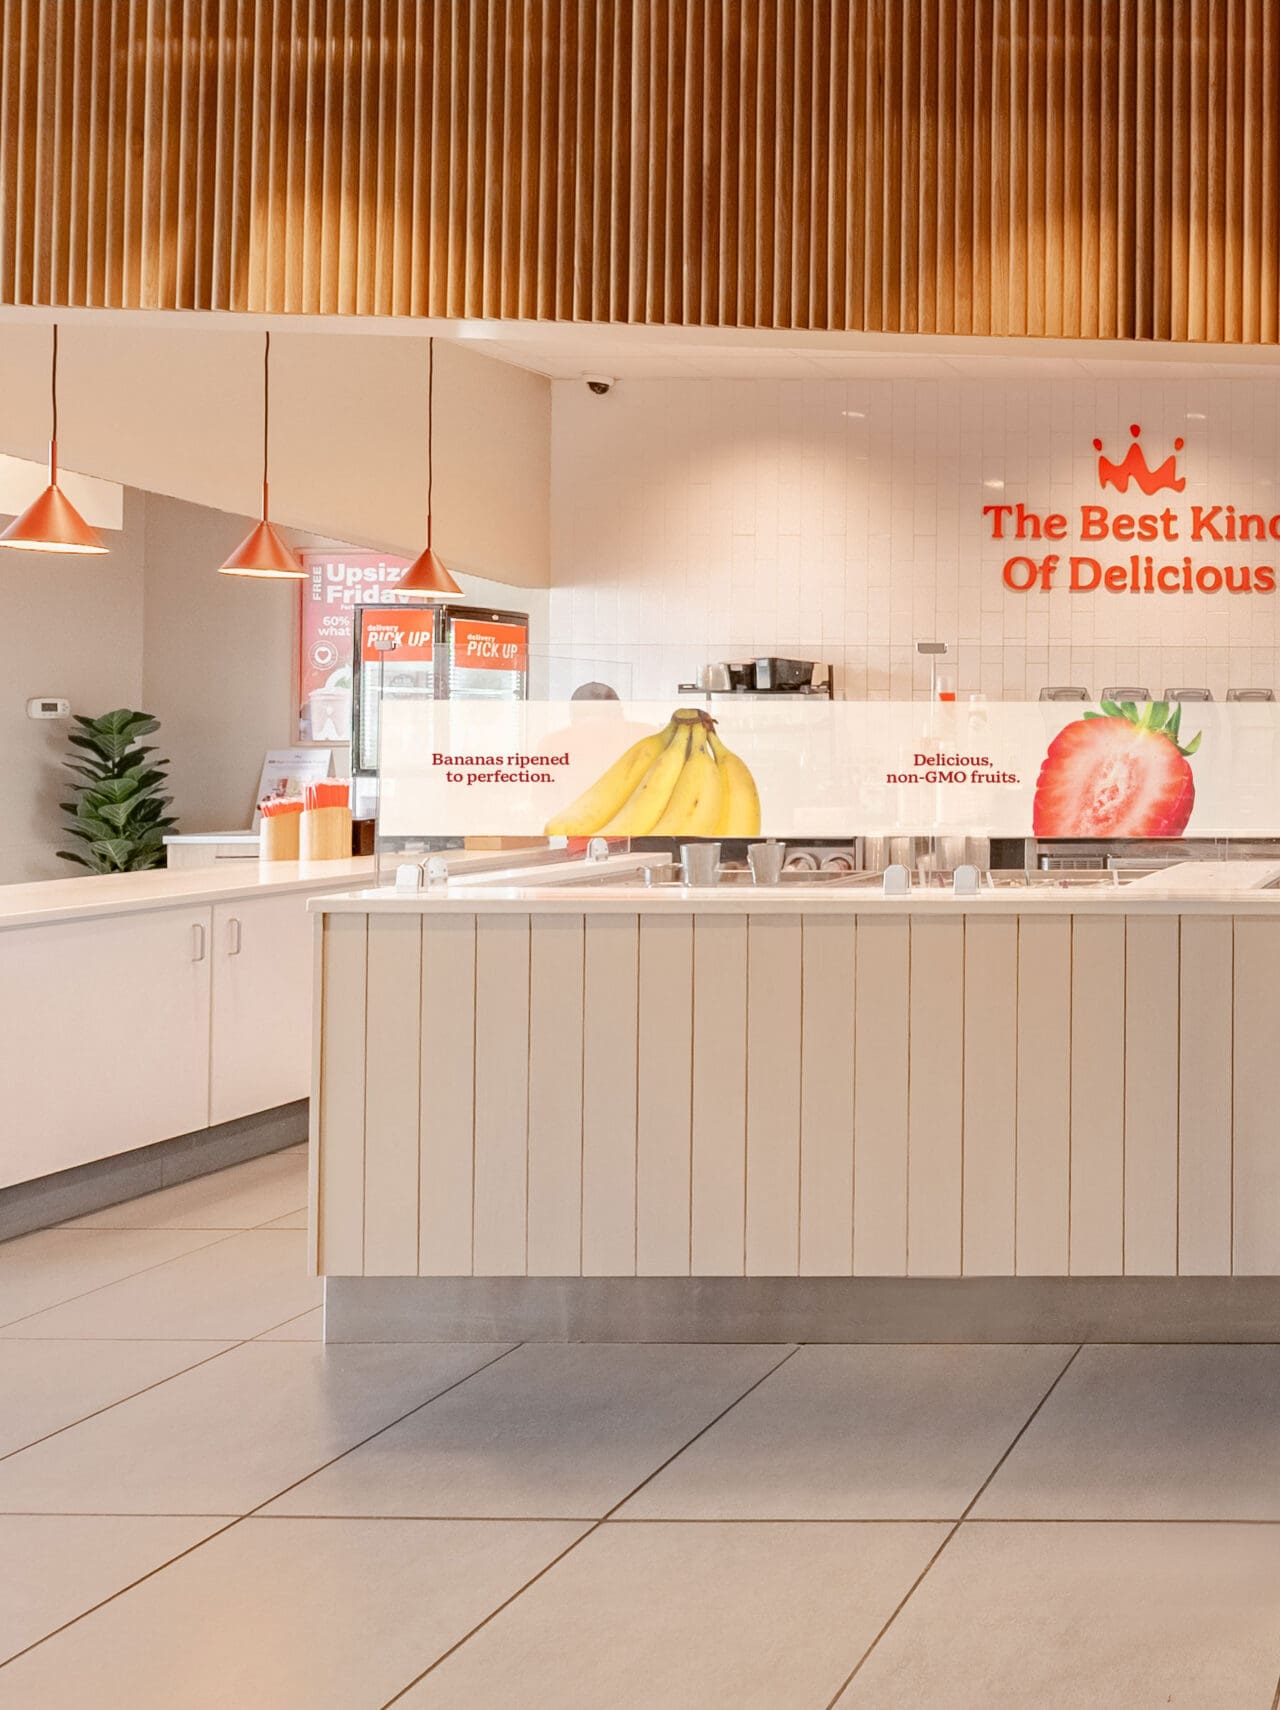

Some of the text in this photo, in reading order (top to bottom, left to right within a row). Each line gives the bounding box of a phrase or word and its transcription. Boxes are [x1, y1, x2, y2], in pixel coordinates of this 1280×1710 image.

[982, 502, 1068, 541] The
[1080, 504, 1179, 541] Best
[1002, 554, 1277, 593] Of Delicious
[312, 566, 323, 601] FREE
[323, 615, 350, 626] 60%
[318, 627, 351, 637] what
[367, 624, 398, 633] delivery
[408, 631, 431, 648] UP
[467, 633, 496, 643] delivery
[467, 641, 518, 659] PICK UP
[432, 753, 570, 769] Bananas ripened
[914, 753, 994, 767] Delicious,
[447, 770, 555, 785] to perfection.
[887, 771, 1021, 784] non-GMO fruits.
